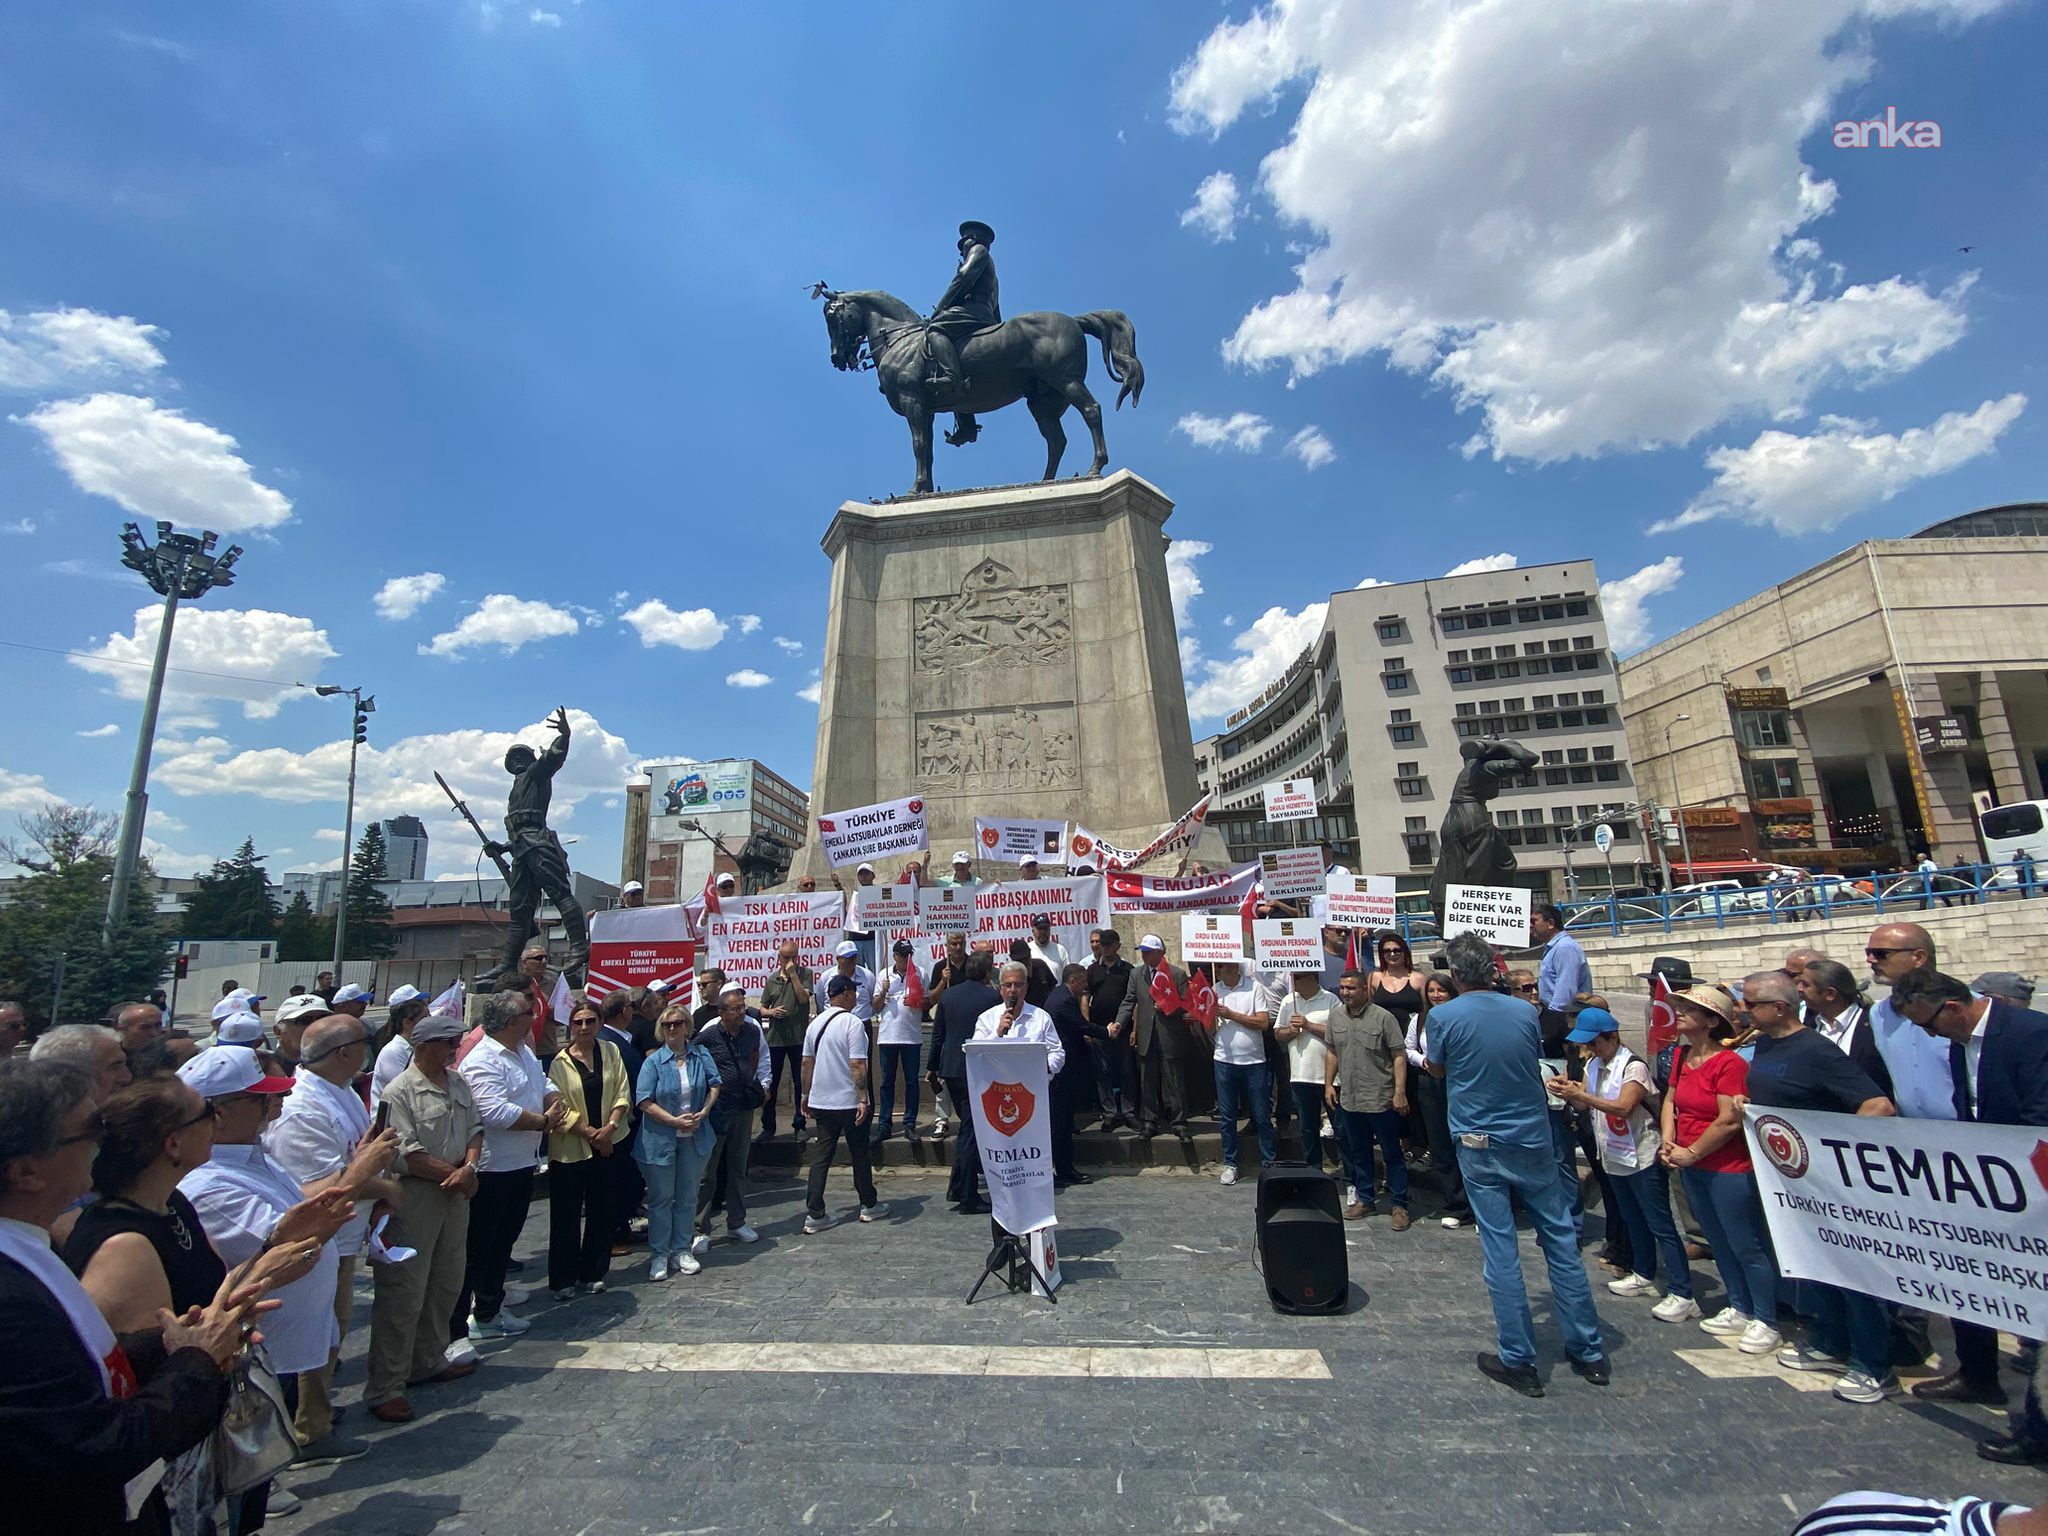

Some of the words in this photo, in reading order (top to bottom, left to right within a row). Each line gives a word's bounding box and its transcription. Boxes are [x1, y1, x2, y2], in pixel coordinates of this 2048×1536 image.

[845, 809, 896, 828] TÜRKİYE
[1271, 809, 1314, 819] SAYMADINIZ
[847, 826, 893, 844] ASTSUBAYLAR
[894, 818, 924, 834] DERNEĞİ
[878, 835, 918, 852] BAŞKANLIĞI
[1153, 872, 1232, 891] EMUJAD
[1270, 885, 1323, 896] BEKLİYORUZ
[1462, 889, 1512, 901] HERŞEYE
[745, 902, 768, 916] TSK
[773, 901, 808, 915] LARIN
[1143, 900, 1174, 911] UZMAN
[1176, 895, 1239, 909] JANDARMALAR
[1452, 900, 1496, 912] ÖDENEK
[1500, 905, 1522, 915] VAR
[712, 923, 727, 935] EN
[733, 921, 769, 934] FAZLA
[774, 916, 809, 935] ŞEHİT
[813, 914, 841, 930] GAZİ
[863, 919, 911, 928] BEKLİYORUZ
[926, 921, 970, 930] İSTİYORUZ
[1332, 914, 1391, 925] BEKLİYORUZ
[1448, 912, 1472, 923] BİZE
[1476, 916, 1525, 928] GELİNCE
[1473, 928, 1496, 938] YOK
[728, 939, 768, 953] VEREN
[1288, 937, 1317, 946] PERSONELİ
[630, 949, 657, 957] TÜRKİYE
[651, 957, 684, 966] ERBAŞLAR
[718, 957, 762, 972] UZMAN
[1261, 958, 1321, 968] GİREMİYOR
[628, 966, 656, 974] DERNEĞİ
[985, 1146, 1041, 1163] TEMAD
[1001, 1166, 1025, 1175] TÜRKİYE
[1820, 1138, 2027, 1213] TEMAD
[1774, 1190, 1839, 1219] TÜRKİYE
[1841, 1206, 1904, 1231] EMEKLİ
[1908, 1217, 2048, 1257] ASTSUBAYLAR
[1818, 1227, 1926, 1265] ODUNPAZARI
[1928, 1250, 1981, 1277] ŞUBE
[1897, 1276, 2031, 1325] ESKİŞEHİR
